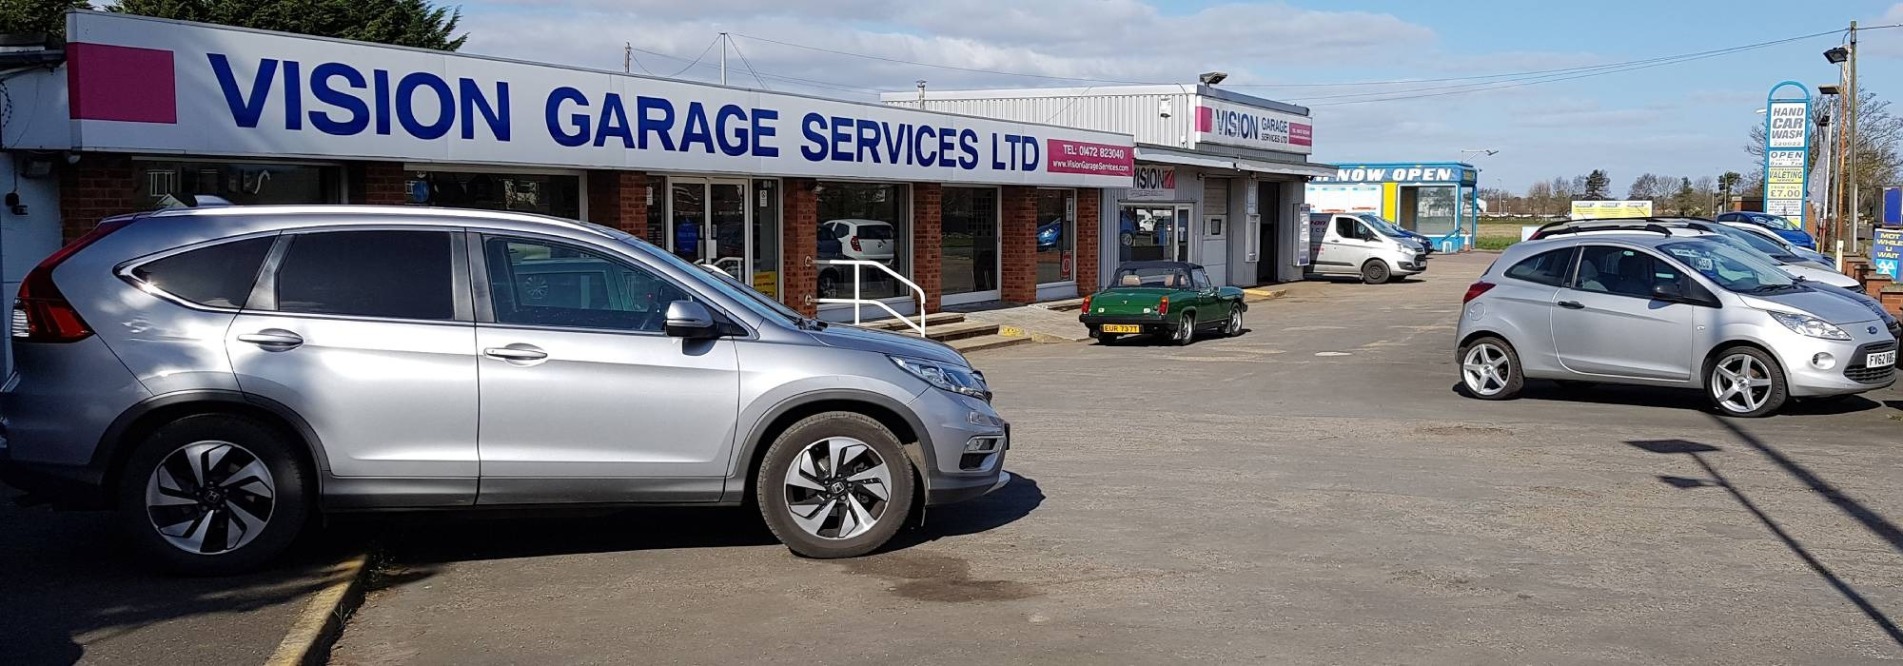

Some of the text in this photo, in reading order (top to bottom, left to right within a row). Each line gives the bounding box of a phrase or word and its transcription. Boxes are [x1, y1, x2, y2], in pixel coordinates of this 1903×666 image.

[207, 53, 1039, 171] VISION GARAGE SERVICES LTD
[1773, 107, 1805, 117] HAND
[1216, 109, 1258, 140] VISION
[1261, 117, 1288, 133] GARAGE
[1772, 117, 1804, 129] CAR
[1261, 133, 1280, 143] SERVICES
[1771, 129, 1803, 139] WASH
[1062, 144, 1124, 159] TEL: 01472 823040
[1770, 151, 1803, 159] OPEN
[1052, 159, 1129, 172] www.VisionGarageServices.com
[1336, 168, 1386, 182] NOW
[1392, 168, 1451, 182] OPEN
[1769, 171, 1803, 179] VALETING
[1770, 189, 1801, 198] £7.00
